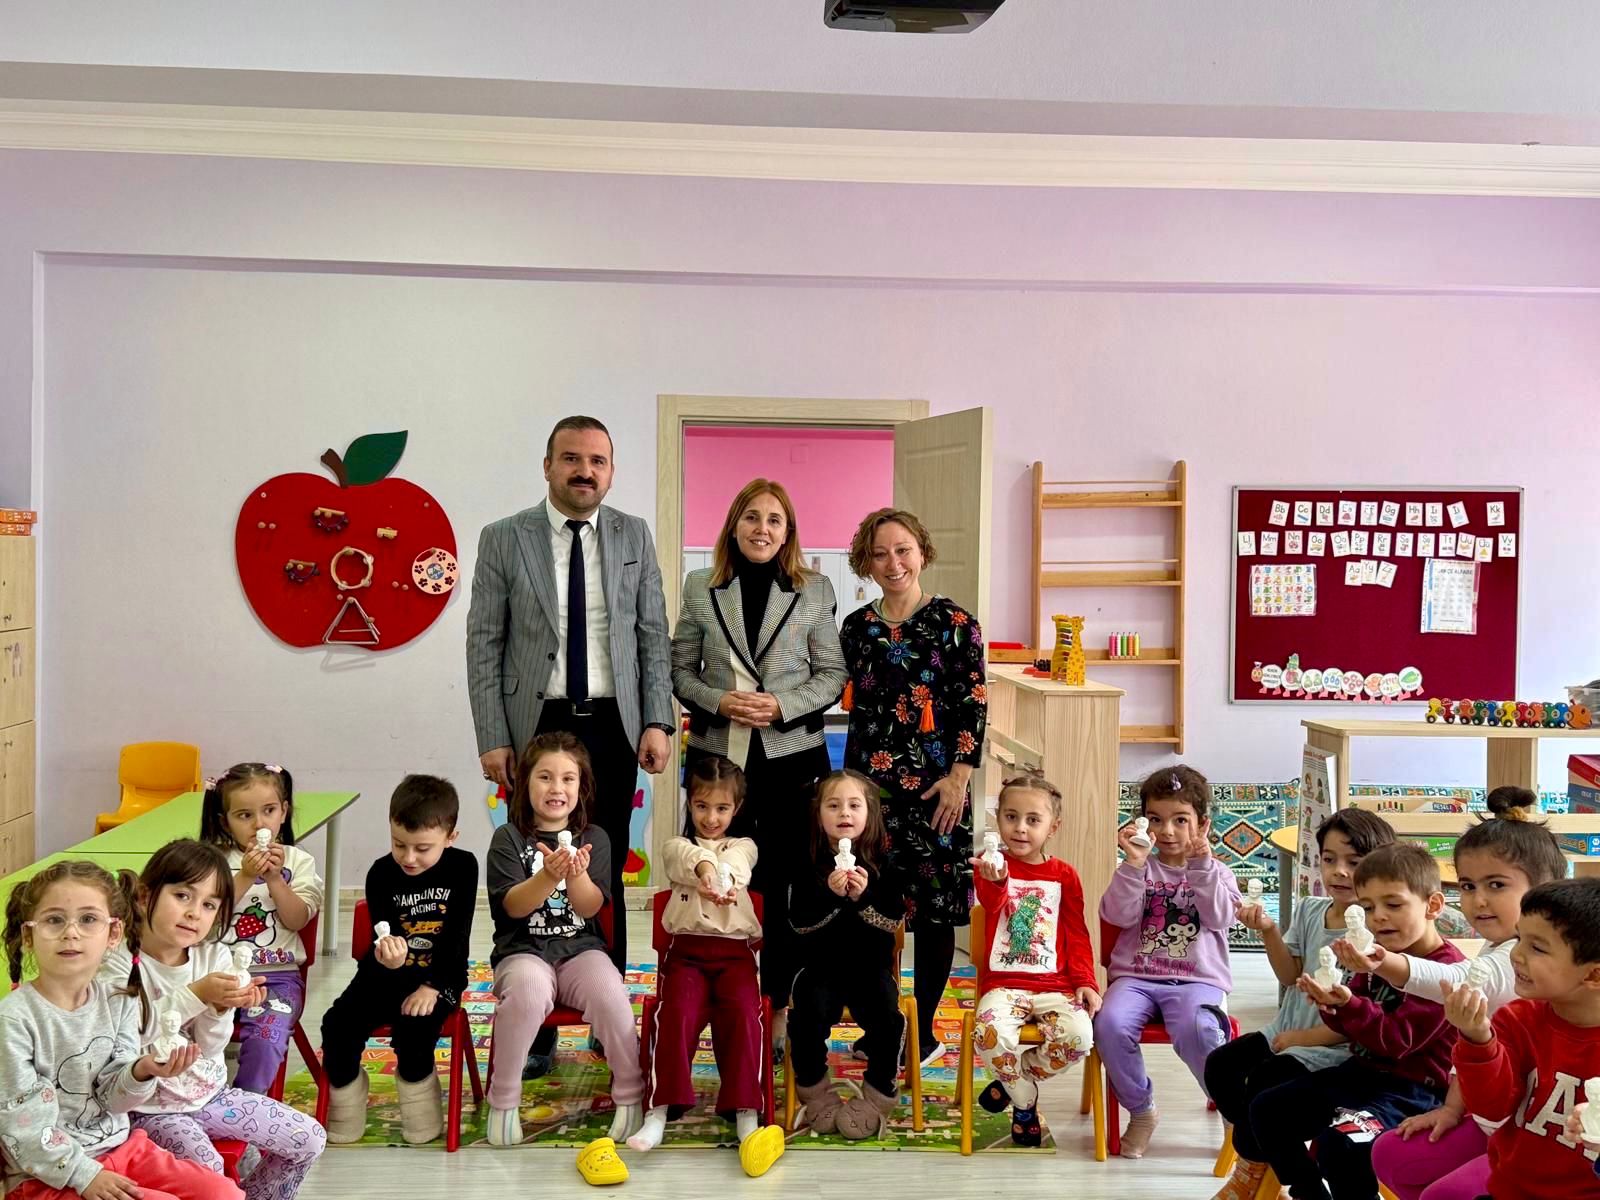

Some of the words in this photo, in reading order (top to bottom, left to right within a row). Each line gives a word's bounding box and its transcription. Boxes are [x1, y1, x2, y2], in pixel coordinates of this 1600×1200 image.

[1275, 503, 1286, 514] Bb
[1319, 505, 1331, 514] Dd
[1408, 505, 1420, 514] Hh
[1490, 505, 1501, 514] Kk
[1262, 533, 1277, 542] Mm
[1287, 532, 1300, 541] Nn
[1354, 533, 1365, 543] Pp
[1377, 534, 1388, 543] Rr
[1442, 534, 1453, 544] Tt
[1501, 534, 1513, 543] Vv
[1348, 565, 1360, 573] Aa
[1363, 561, 1374, 573] Yy
[529, 926, 561, 936] HELLO
